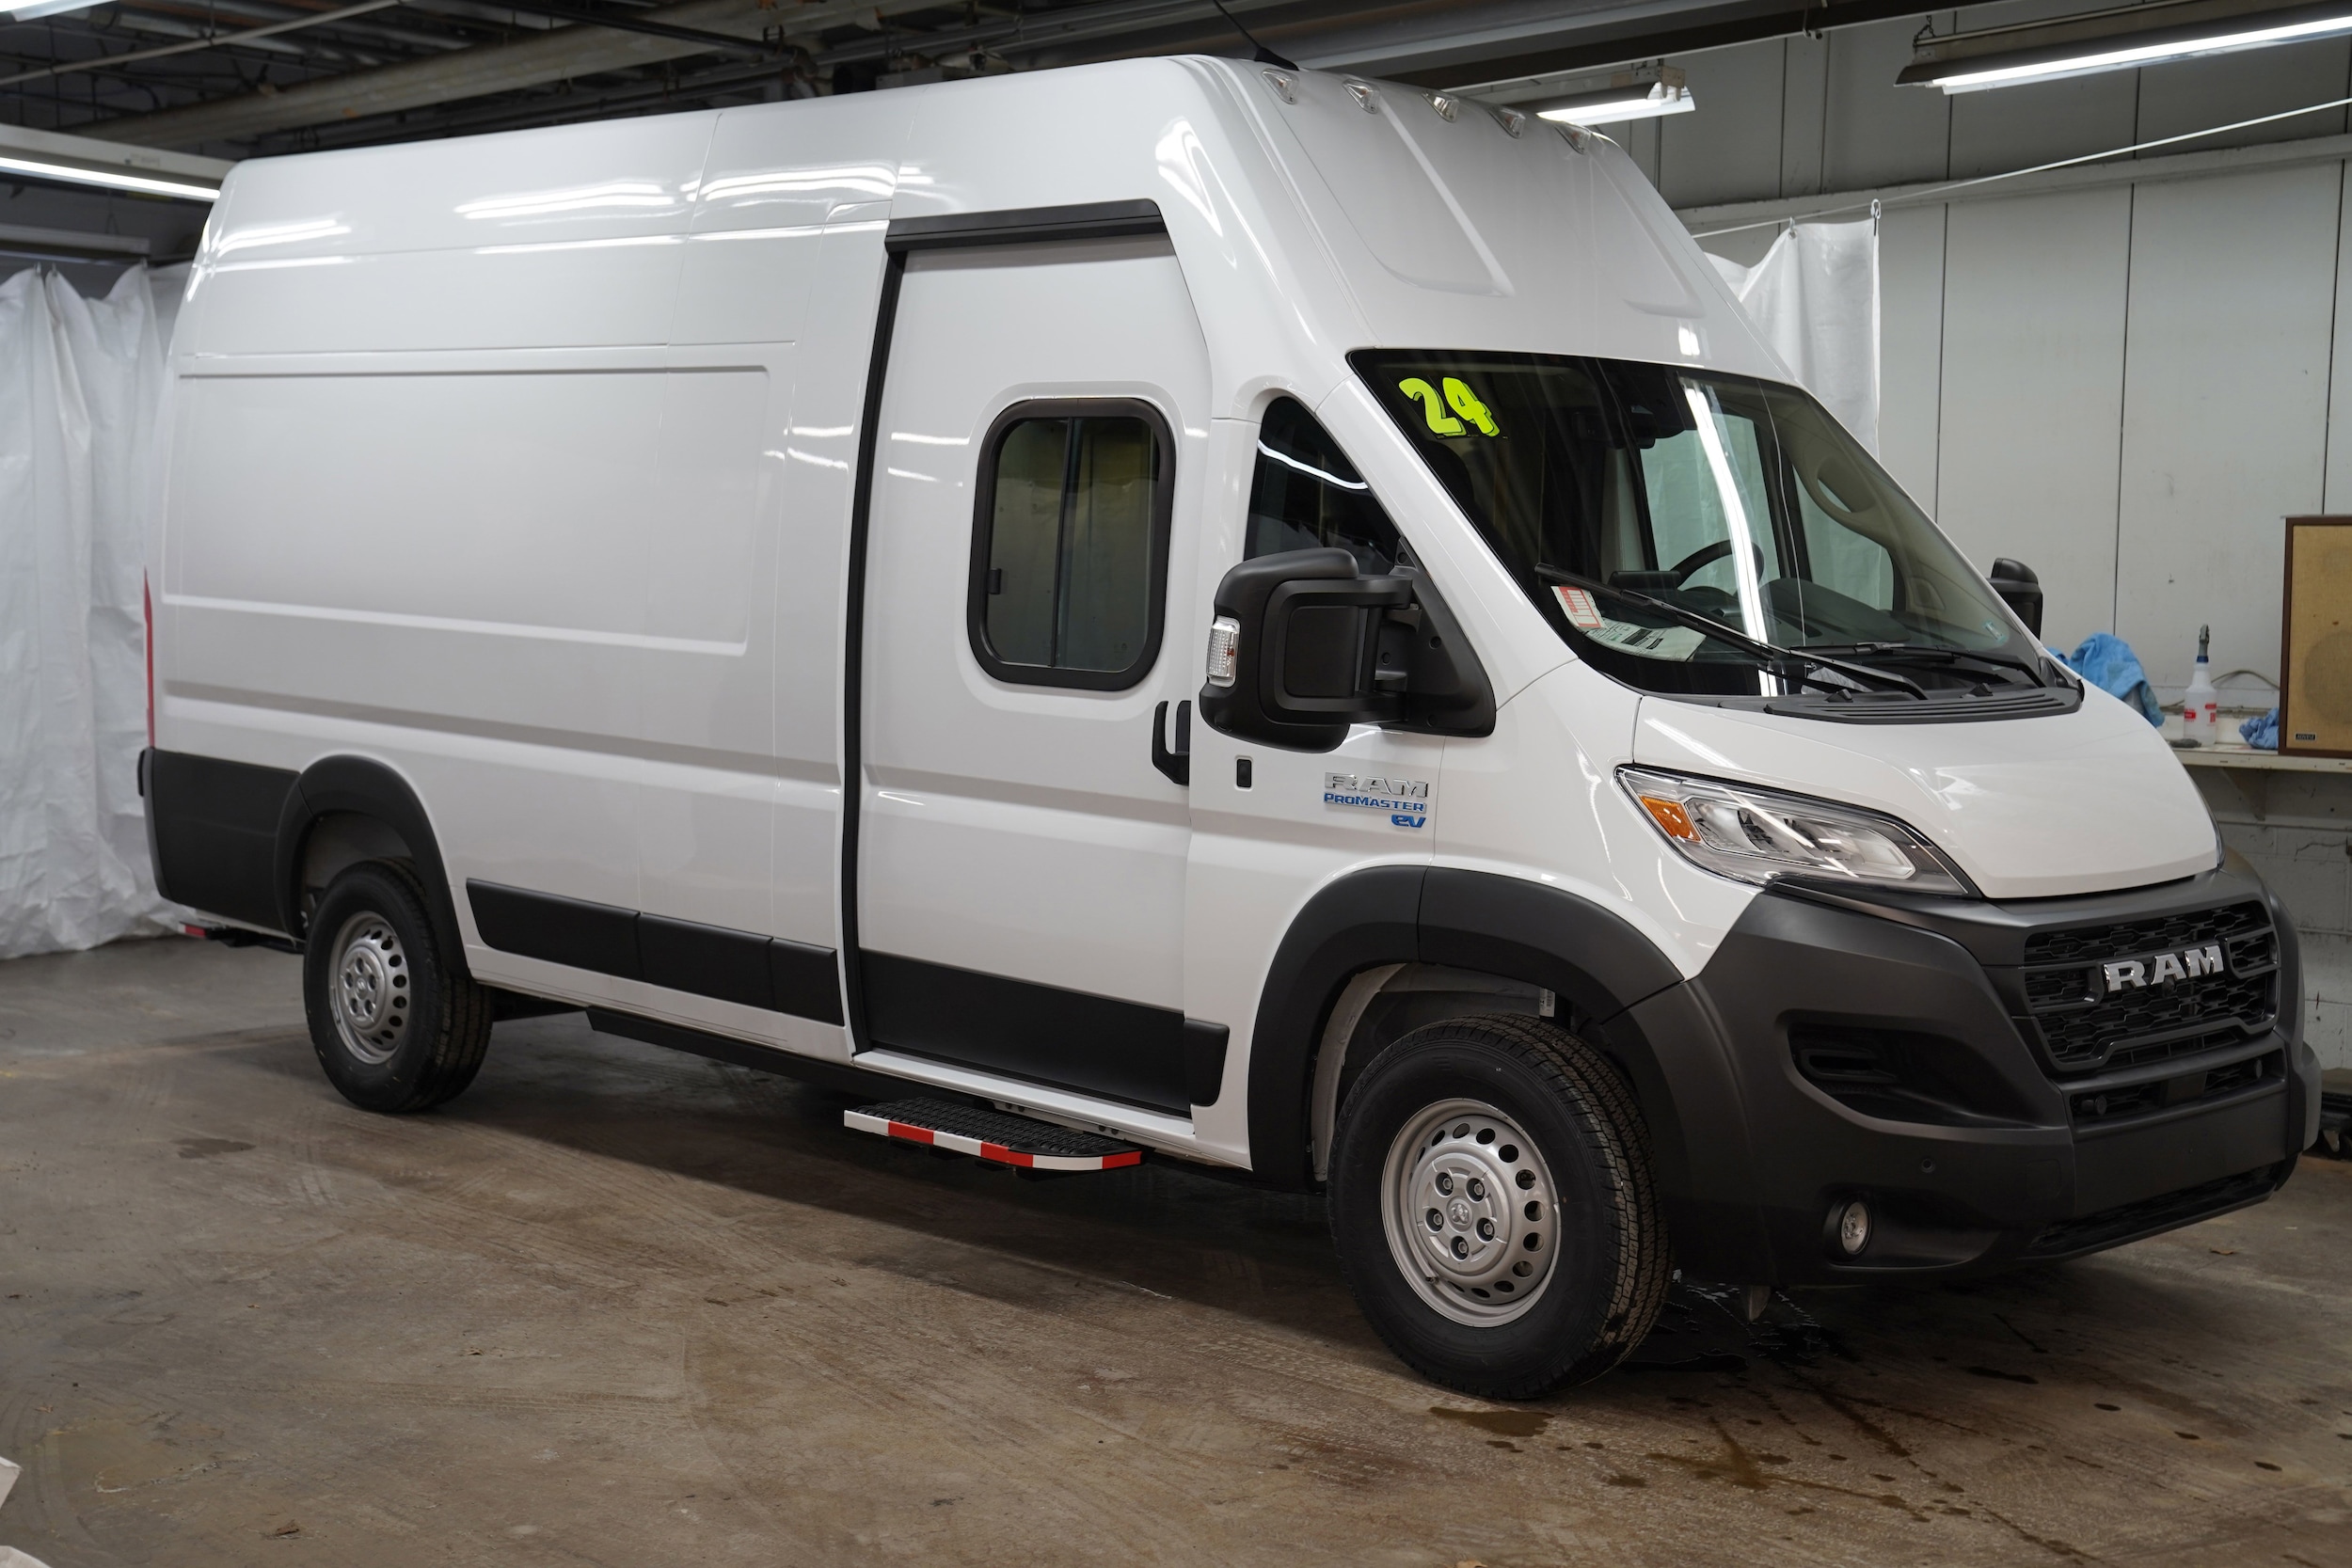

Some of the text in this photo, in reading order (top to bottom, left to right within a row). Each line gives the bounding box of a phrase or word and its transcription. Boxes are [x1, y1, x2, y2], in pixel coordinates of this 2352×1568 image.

[1398, 377, 1500, 436] 24
[1324, 793, 1424, 811] PROMASTER
[1325, 772, 1428, 798] RAM
[2105, 945, 2224, 992] RAM
